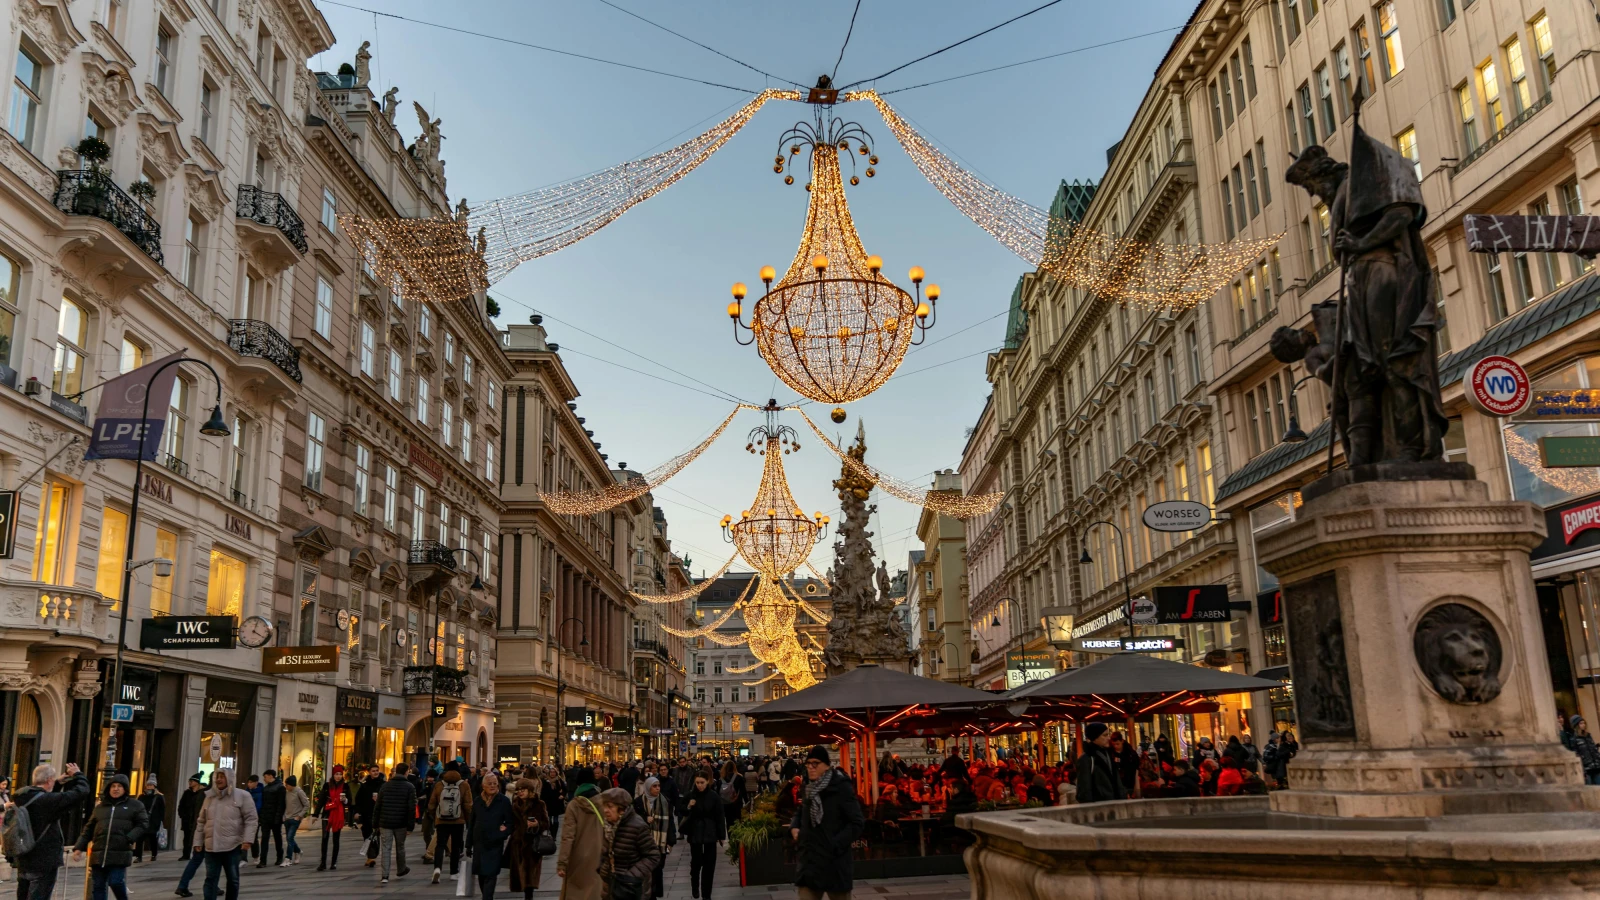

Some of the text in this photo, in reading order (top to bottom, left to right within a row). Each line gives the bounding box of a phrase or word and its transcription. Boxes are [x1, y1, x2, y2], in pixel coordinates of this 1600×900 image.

[98, 423, 151, 441] LPE
[139, 471, 173, 504] LISKA
[1153, 509, 1201, 518] WORSEG
[225, 513, 252, 540] LISKA
[1165, 610, 1226, 620] AM GRABEN
[175, 621, 210, 635] IWC
[122, 684, 141, 701] IWC
[347, 695, 371, 709] KNIZE
